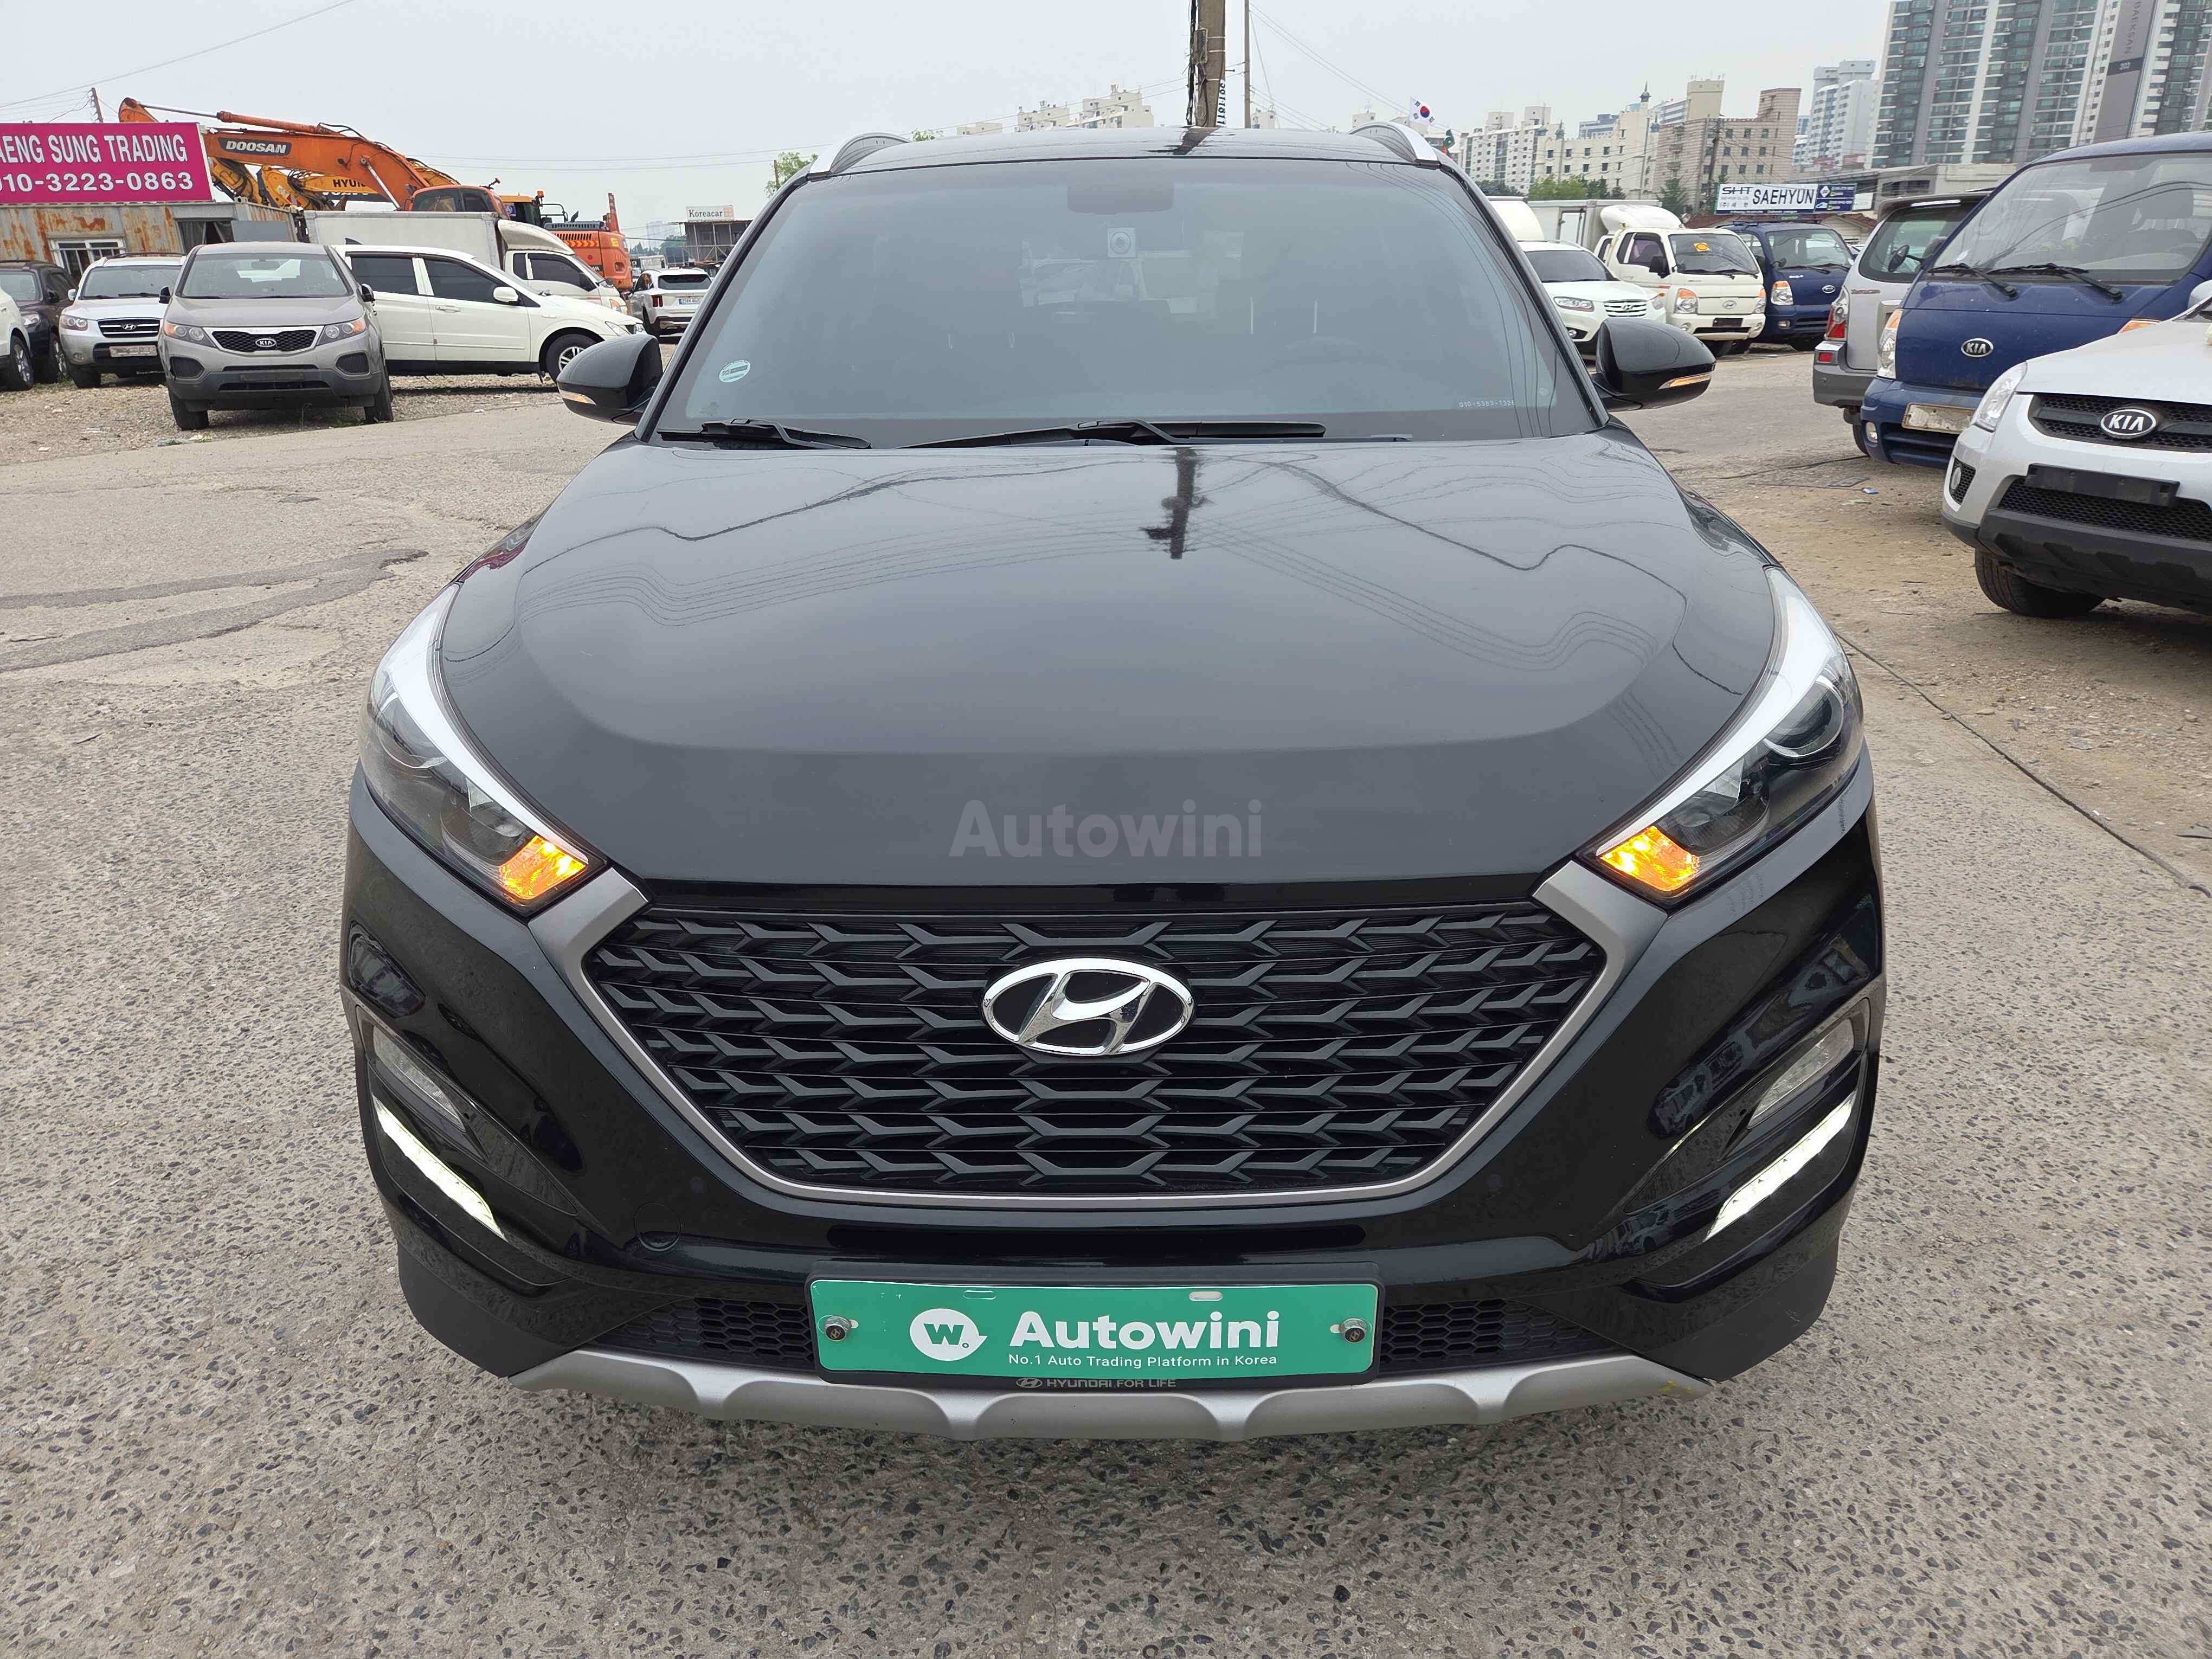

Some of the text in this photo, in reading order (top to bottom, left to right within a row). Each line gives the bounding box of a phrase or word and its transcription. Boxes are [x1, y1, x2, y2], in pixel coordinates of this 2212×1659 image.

[48, 135, 101, 163] SUNG
[104, 134, 188, 162] TRADING
[226, 140, 287, 153] DOOSAN
[0, 172, 193, 192] 10-3223-0863
[1753, 189, 1815, 204] SAEHYUN
[689, 209, 723, 217] Koreacar
[2108, 415, 2144, 431] KIA
[1009, 1311, 1279, 1350] Autowini
[1008, 1354, 1277, 1369] No.1 Auto Trading Platform in Korea
[1046, 1379, 1176, 1388] HYUNDAI FOR LIFE
